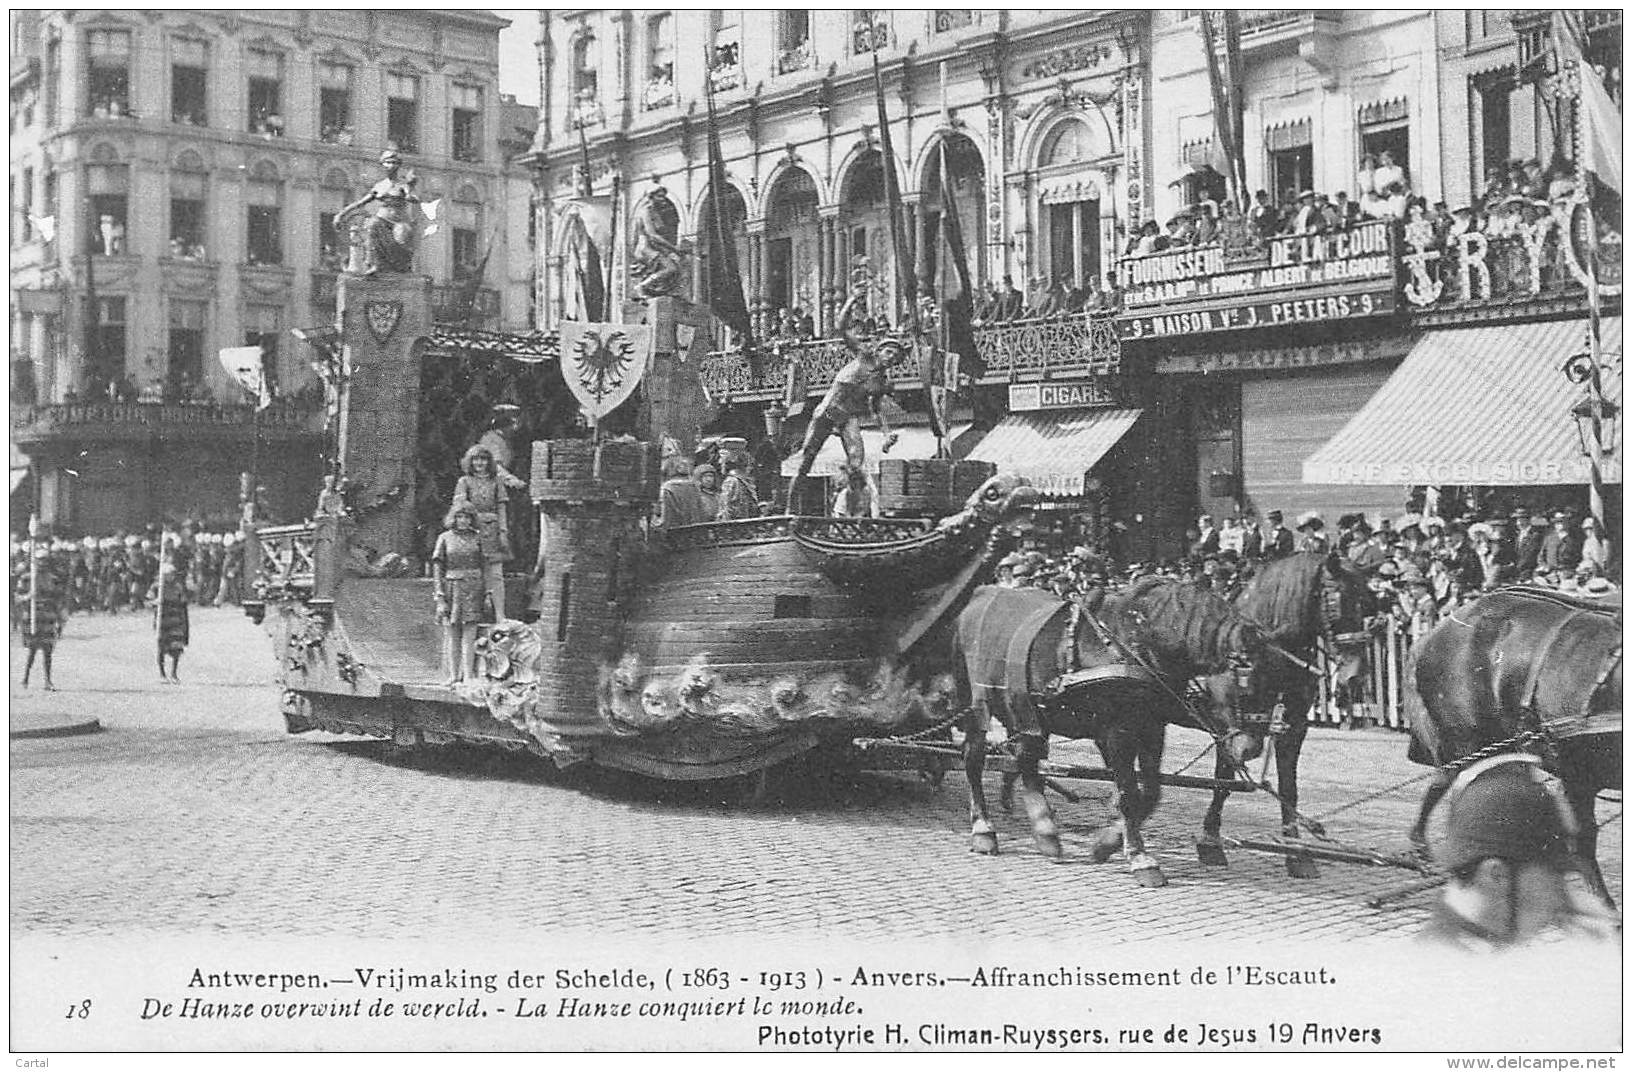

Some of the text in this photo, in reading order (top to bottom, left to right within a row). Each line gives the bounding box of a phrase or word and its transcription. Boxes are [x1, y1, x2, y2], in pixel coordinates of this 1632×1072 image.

[1124, 224, 1388, 287] FOURNISSEUR DE LA COUR
[1211, 273, 1255, 293] PRINCE
[1260, 265, 1308, 288] ALBERT
[1324, 256, 1390, 280] BELGIQUE
[1152, 311, 1212, 335] MAISON
[1270, 295, 1350, 323] PEETERS
[1398, 461, 1565, 482] EXCELSIOR
